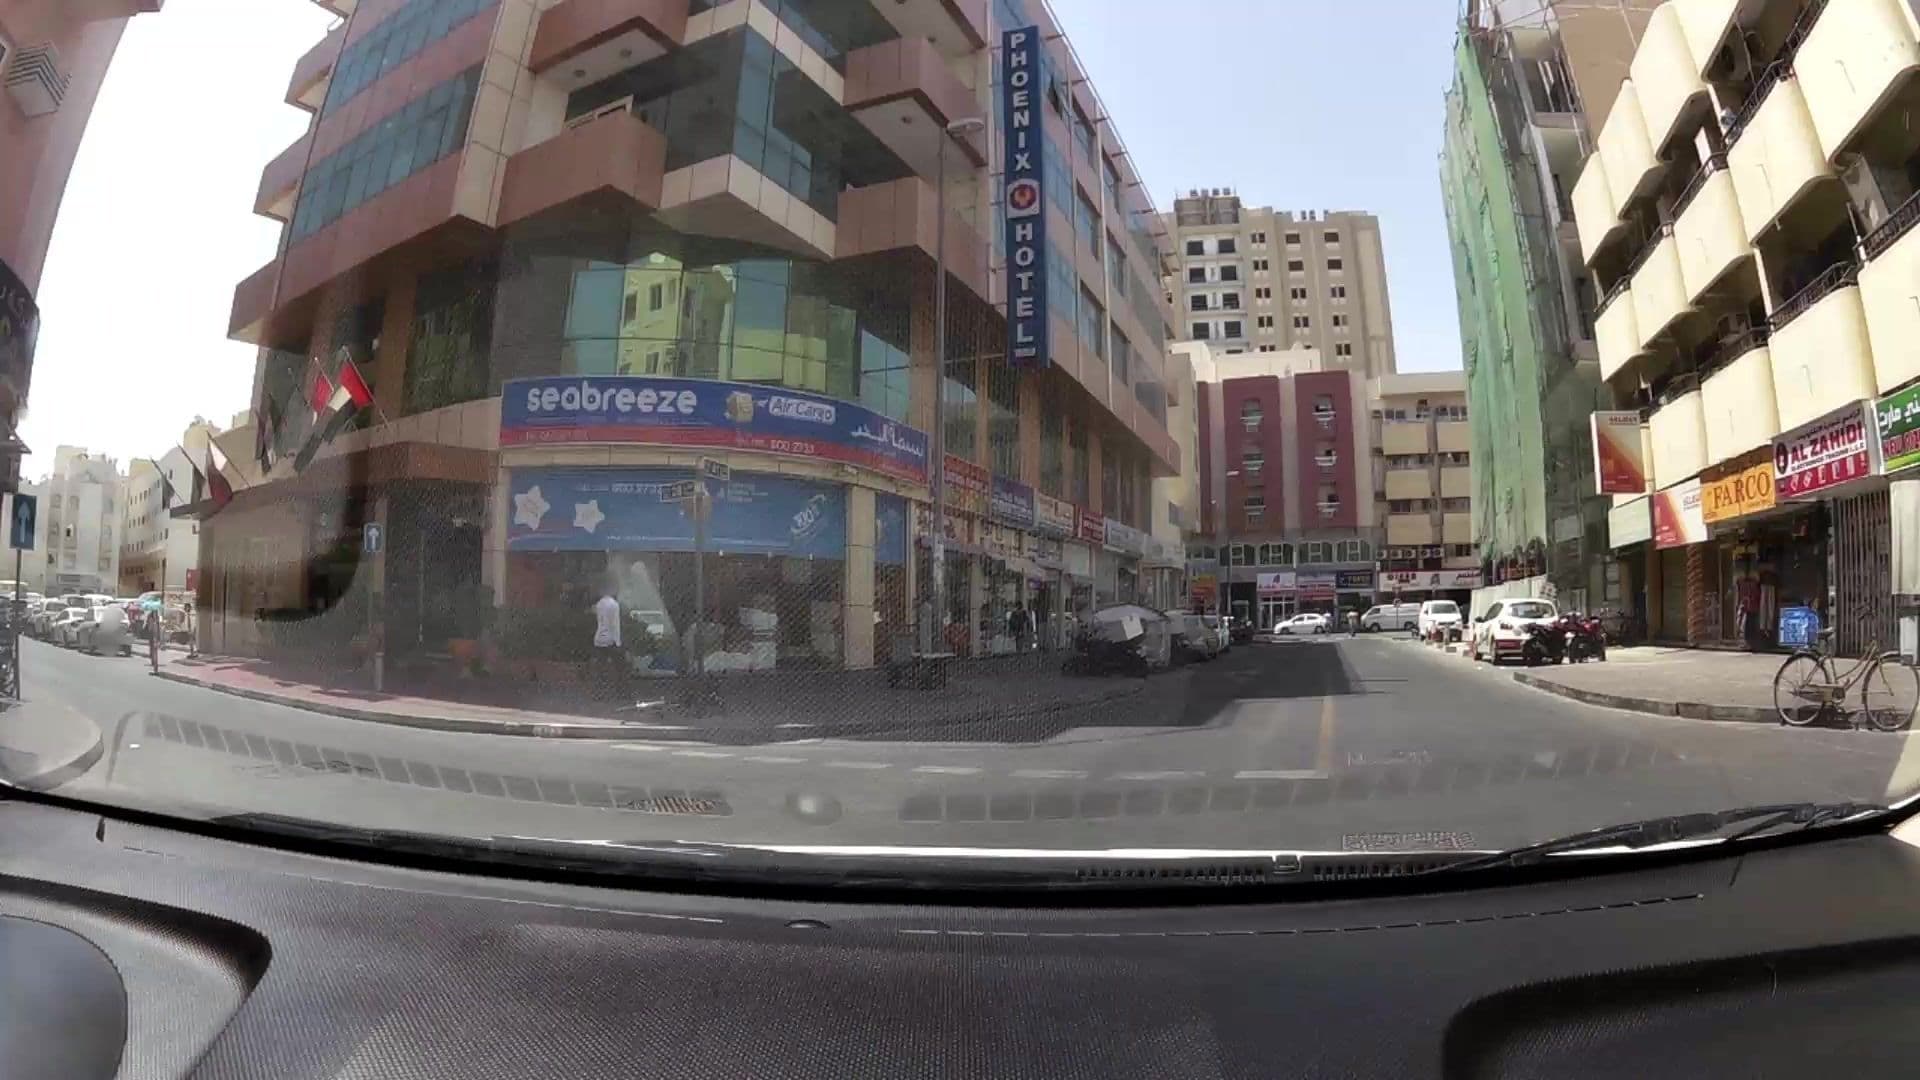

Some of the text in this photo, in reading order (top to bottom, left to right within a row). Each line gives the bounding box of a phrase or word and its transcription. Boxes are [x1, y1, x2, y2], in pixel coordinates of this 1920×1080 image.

[1009, 32, 1035, 343] PHOENIX HOTEL
[527, 380, 697, 415] seabreeze
[772, 398, 834, 424] Air Cargo
[1791, 443, 1809, 463] AL
[1809, 420, 1865, 457] ZAHIDI
[1713, 471, 1771, 510] FARCO
